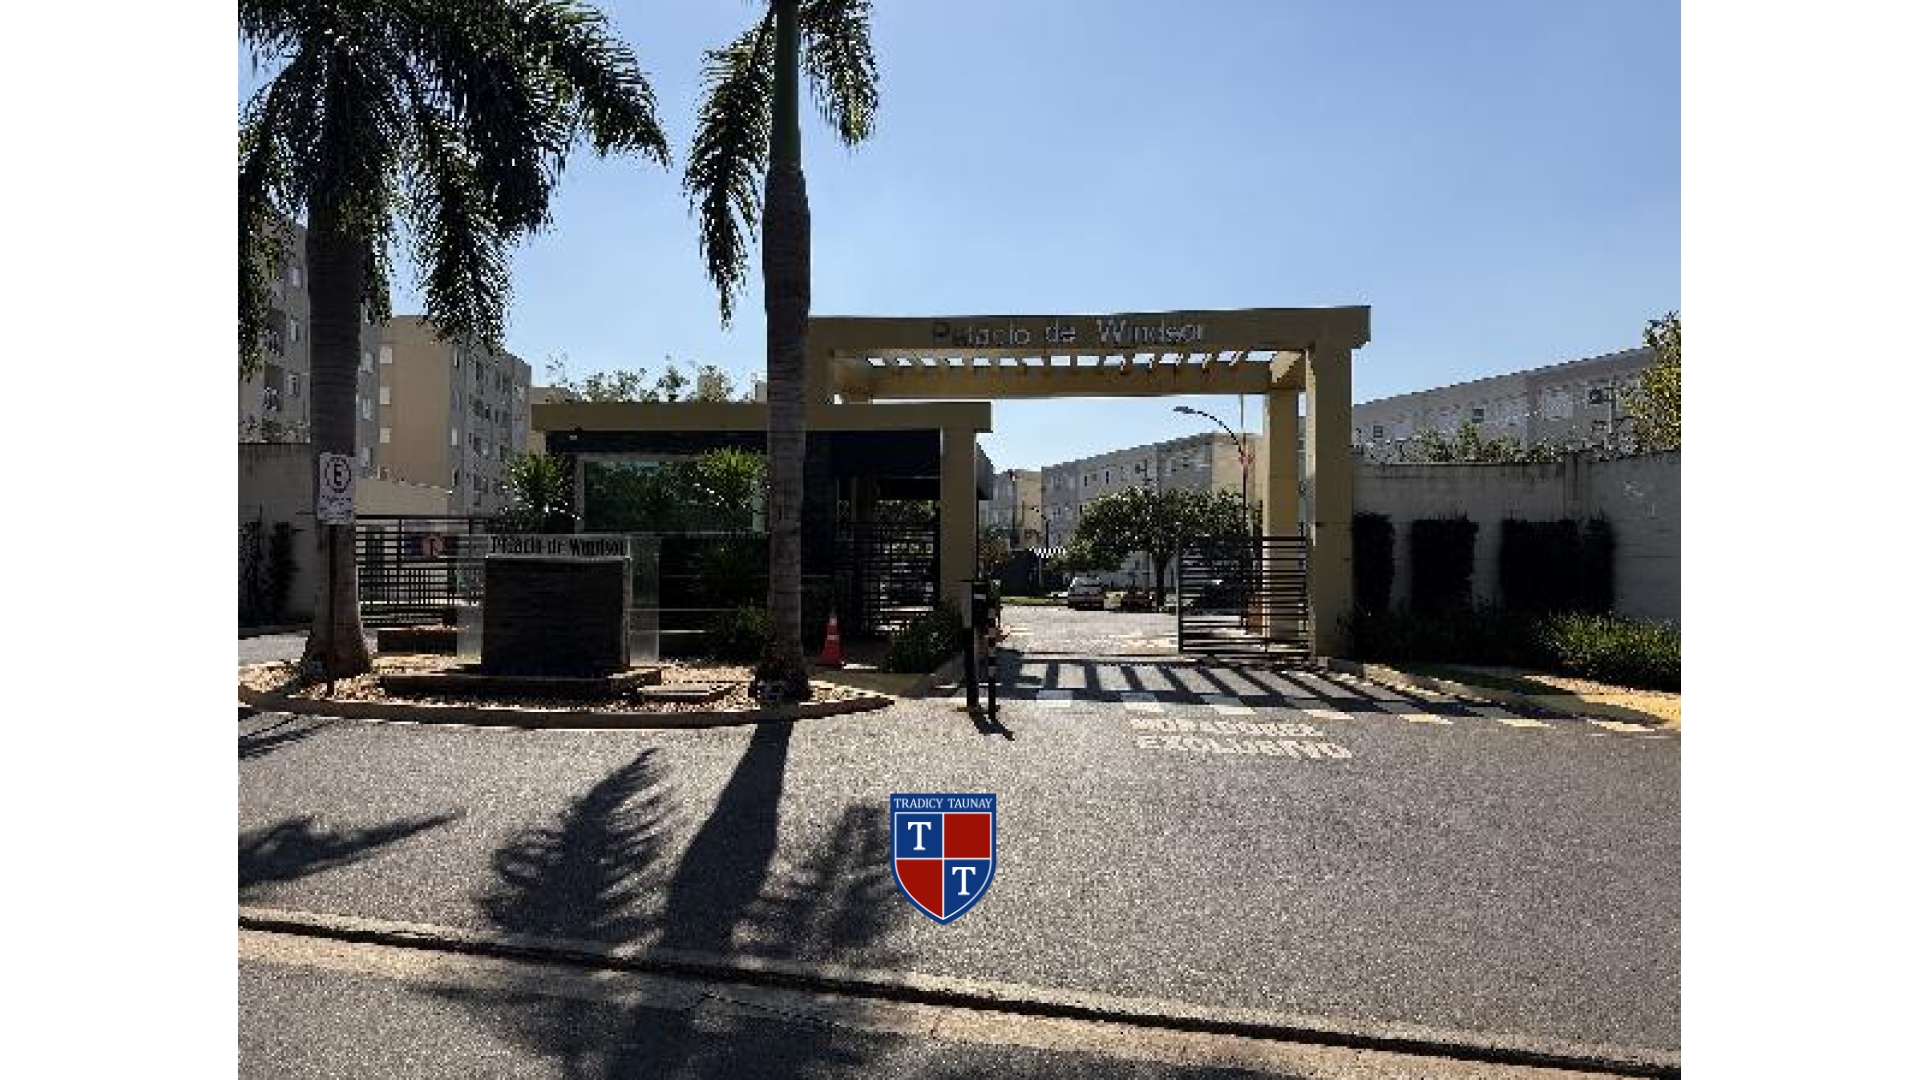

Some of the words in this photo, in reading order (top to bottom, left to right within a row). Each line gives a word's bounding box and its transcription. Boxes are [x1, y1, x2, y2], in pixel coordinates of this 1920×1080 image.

[1045, 318, 1076, 343] de
[1097, 317, 1202, 343] Windsor
[333, 463, 343, 486] E
[547, 537, 565, 554] de
[569, 537, 624, 556] Windsor
[1136, 735, 1352, 759] EXCLUSIVO
